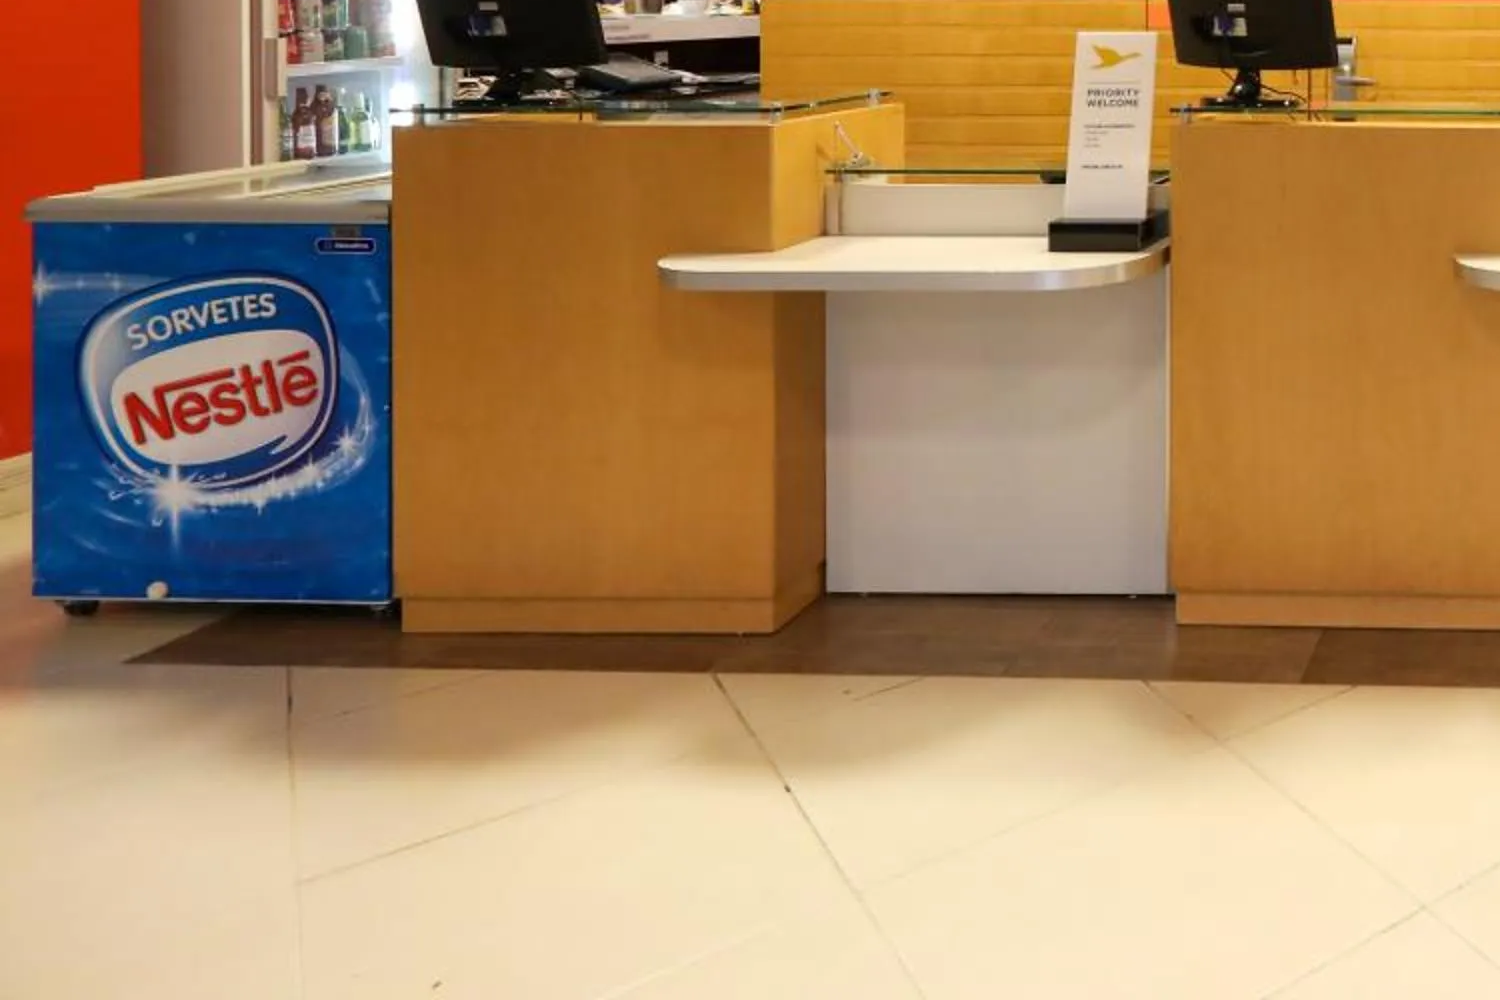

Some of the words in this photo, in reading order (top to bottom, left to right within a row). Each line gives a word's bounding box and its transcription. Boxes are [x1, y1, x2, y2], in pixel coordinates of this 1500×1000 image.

[1087, 88, 1140, 98] PRIORITY
[1086, 98, 1139, 108] WELCOME
[127, 293, 277, 350] SORVETES
